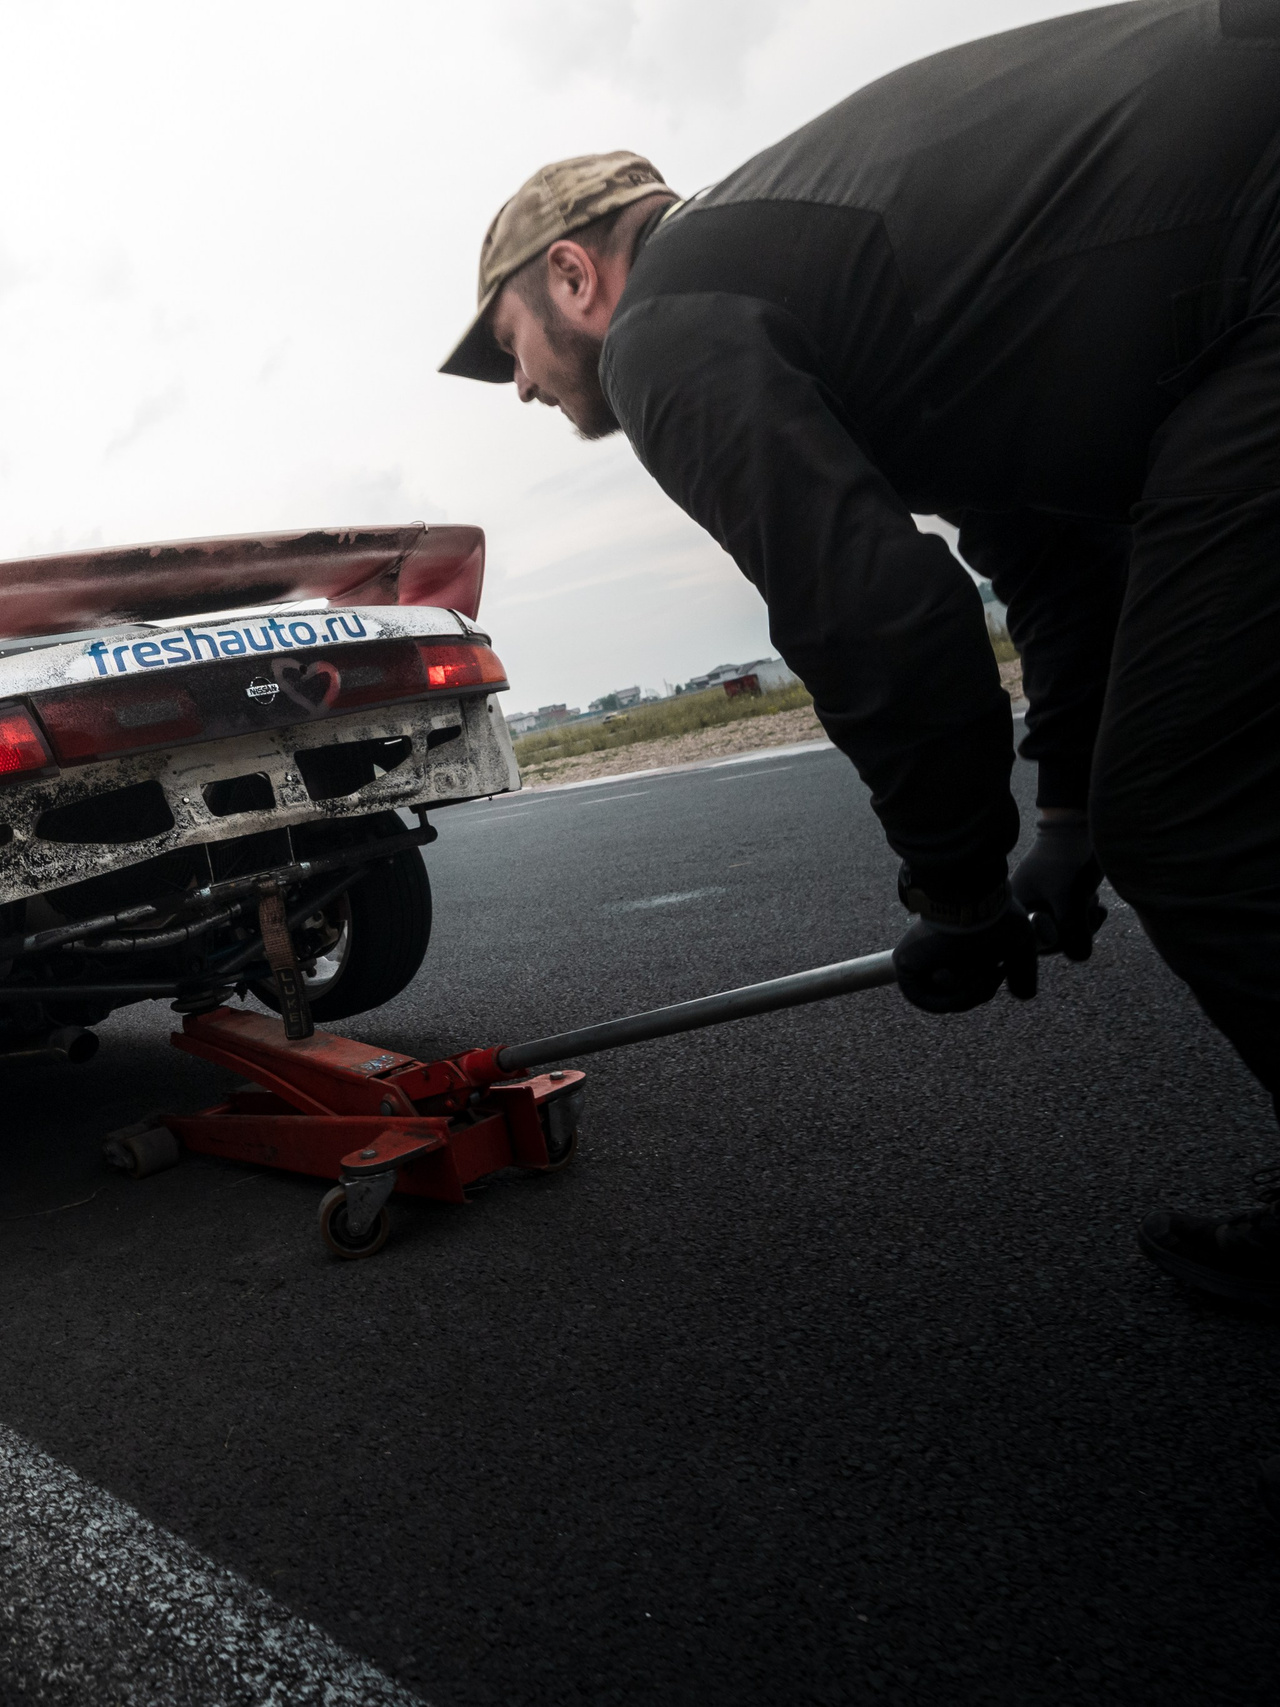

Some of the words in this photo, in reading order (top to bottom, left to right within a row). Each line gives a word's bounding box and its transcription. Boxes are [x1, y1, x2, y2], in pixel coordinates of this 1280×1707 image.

[89, 614, 368, 676] freshauto.ru
[248, 684, 278, 696] NISSAN
[280, 972, 300, 1022] LUKE
